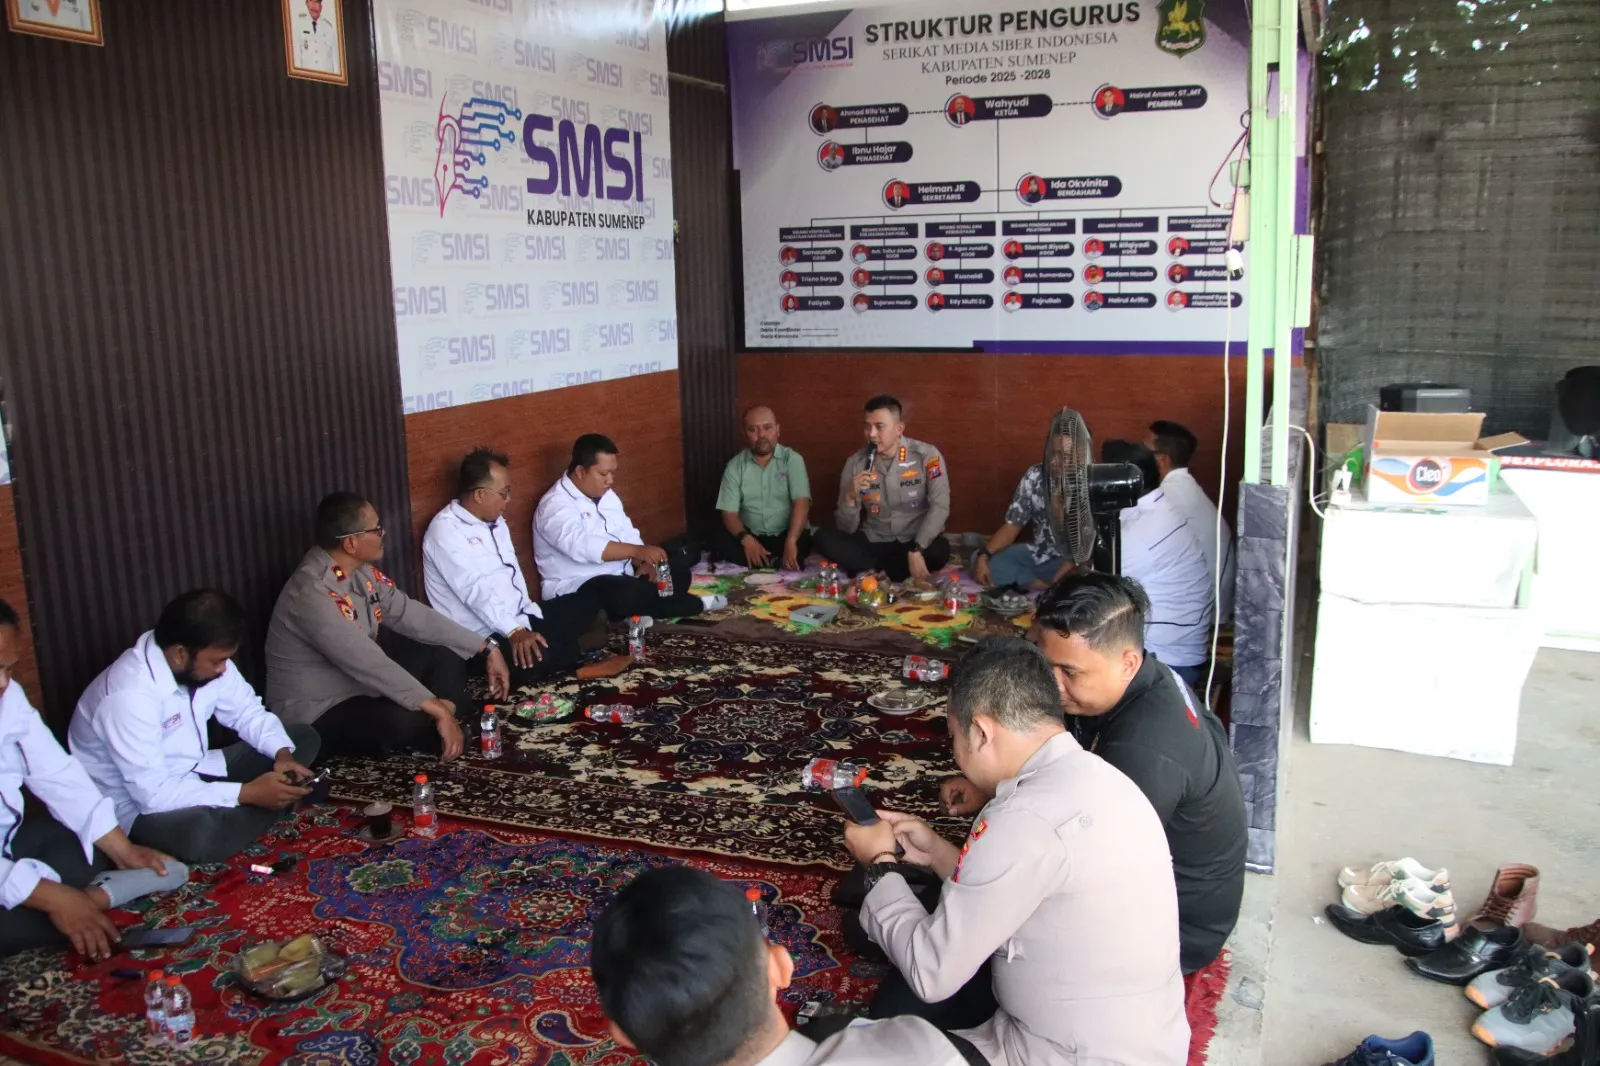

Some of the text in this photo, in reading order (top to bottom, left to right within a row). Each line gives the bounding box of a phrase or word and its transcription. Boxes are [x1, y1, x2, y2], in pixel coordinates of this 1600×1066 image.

[865, 2, 1141, 43] STRUKTUR PENGURUS
[793, 36, 853, 63] SMSI
[882, 32, 1119, 61] SERIKAT MEDIA SIBER INDONESIA
[921, 52, 1077, 74] KABUPATEN SUMENEP
[945, 74, 987, 86] Periode
[991, 71, 1017, 82] 2025
[985, 97, 1029, 109] Wahyudi
[850, 116, 889, 124] PENASEHAT
[994, 109, 1019, 117] KETUA
[523, 113, 644, 202] SMSI
[852, 145, 897, 155] Ibnu Hajar
[855, 154, 893, 162] PENASEHAT
[1051, 178, 1108, 189] Ida Okvinita
[1057, 188, 1101, 197] BENDAHARA
[527, 209, 645, 230] KABUPATEN SUMENEP
[1416, 465, 1441, 482] Cleo
